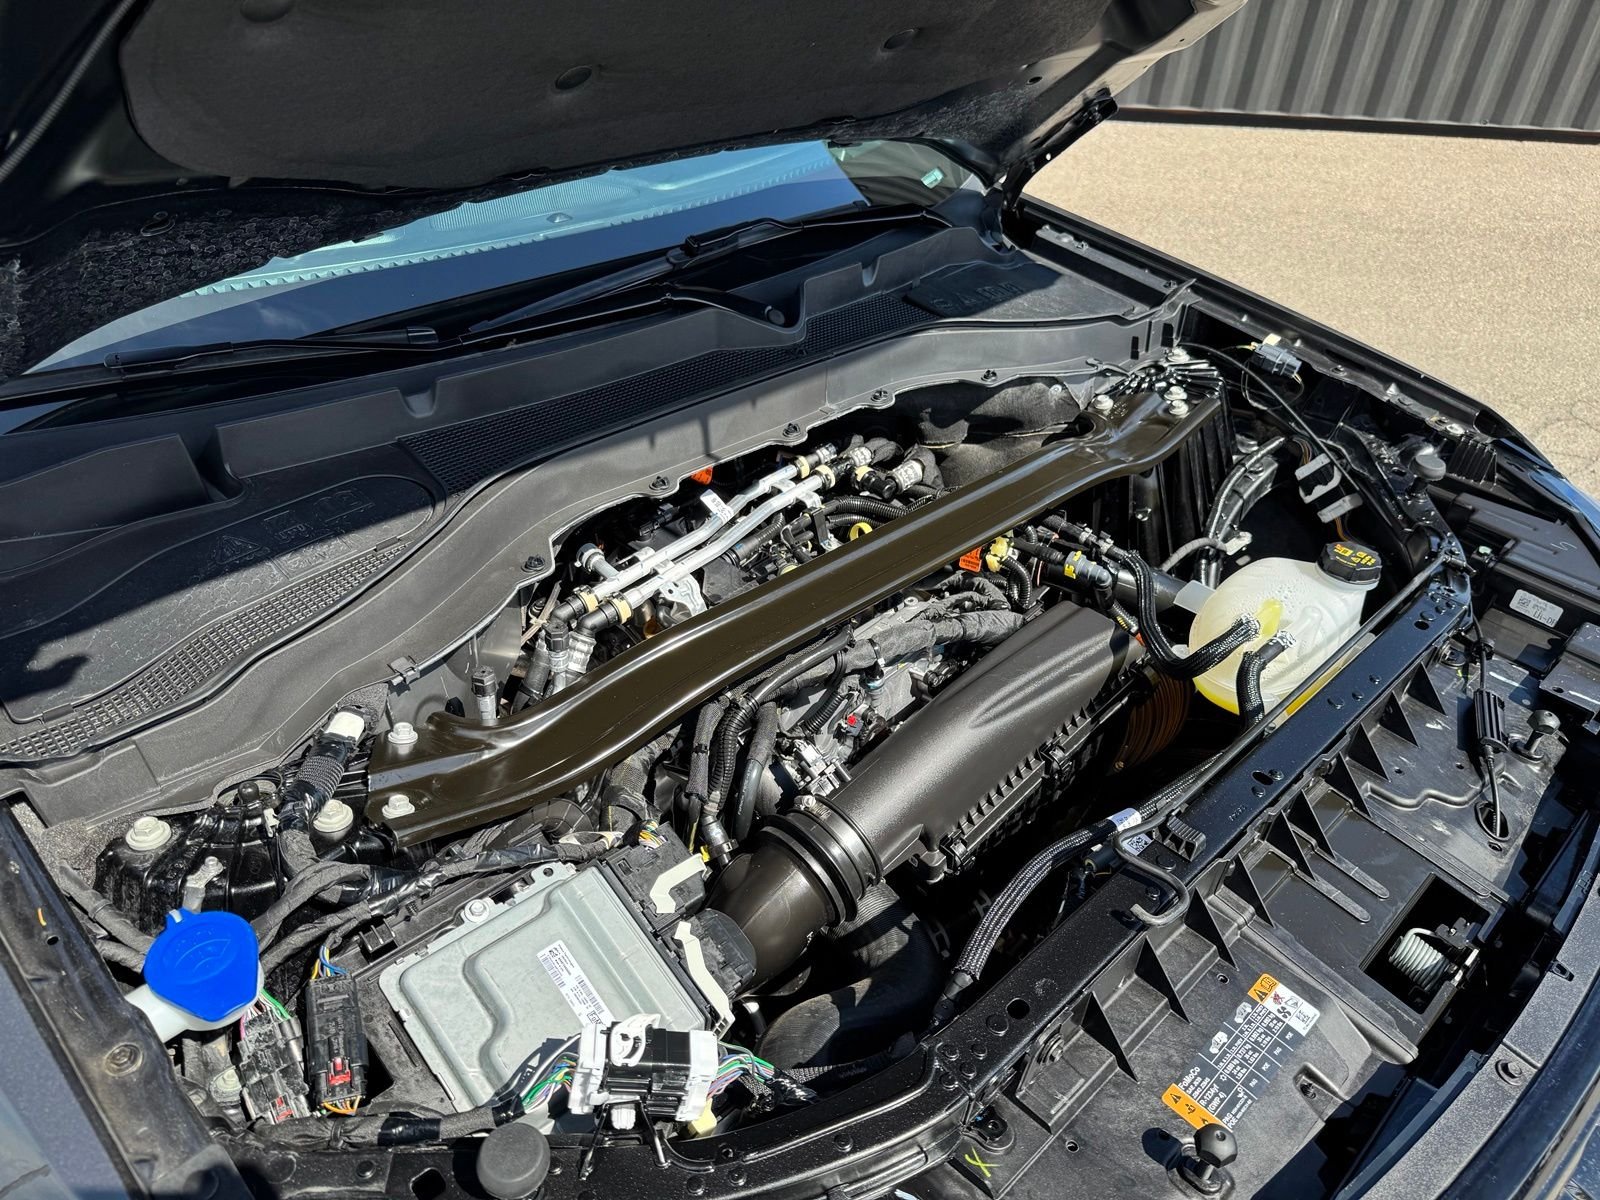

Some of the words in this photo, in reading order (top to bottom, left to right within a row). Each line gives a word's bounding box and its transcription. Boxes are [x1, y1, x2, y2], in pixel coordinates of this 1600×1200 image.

[1178, 1065, 1201, 1090] FoMoCo
[1199, 1083, 1220, 1107] R-1234yf
[1222, 1112, 1233, 1124] PAG
[1227, 1116, 1238, 1129] POE
